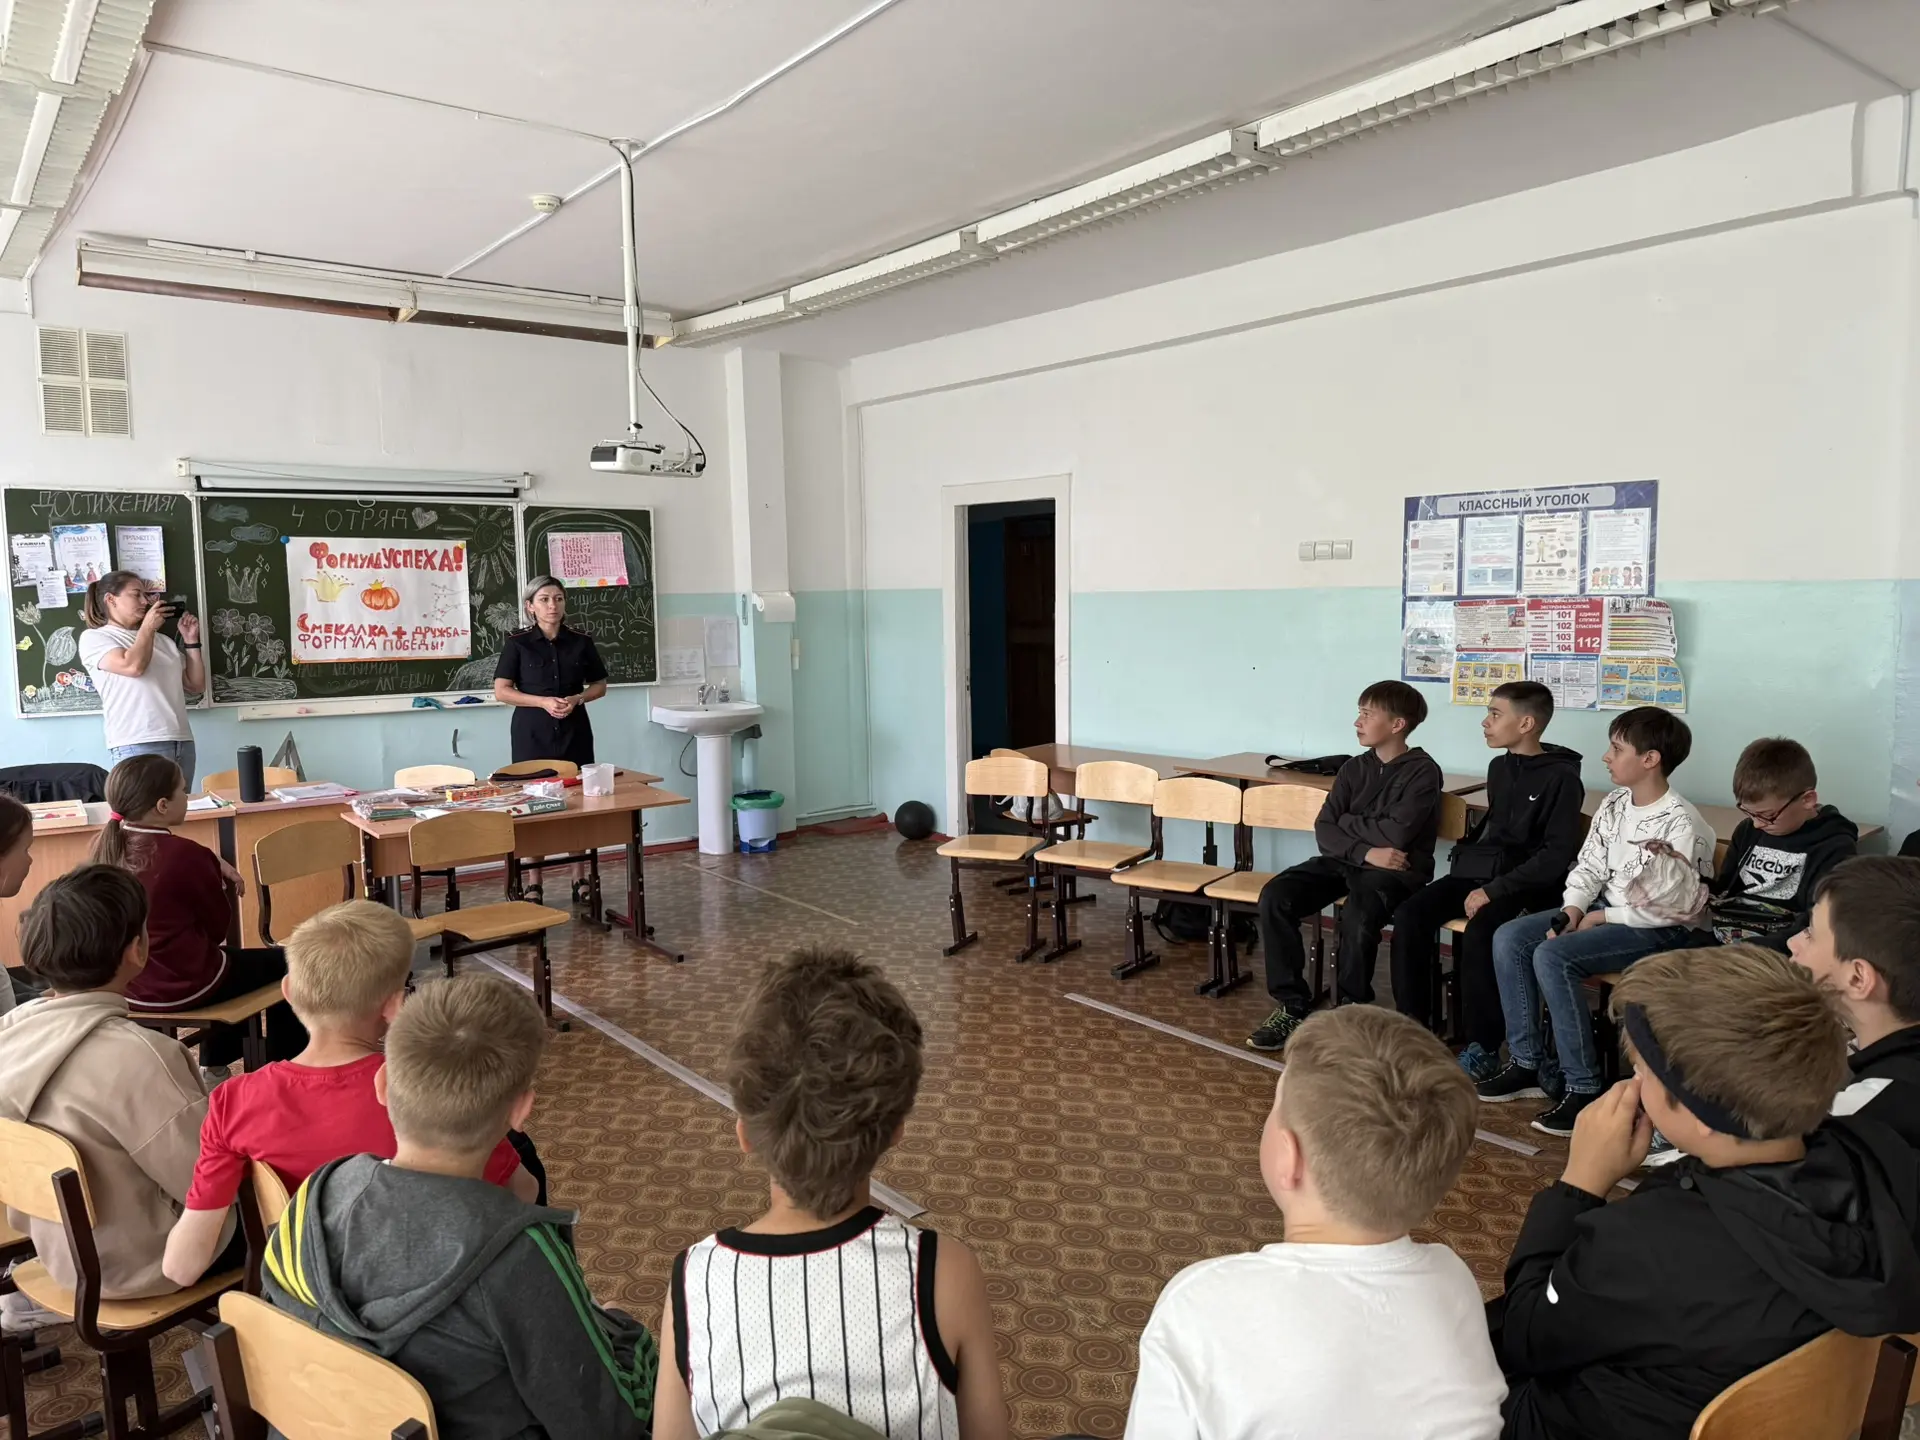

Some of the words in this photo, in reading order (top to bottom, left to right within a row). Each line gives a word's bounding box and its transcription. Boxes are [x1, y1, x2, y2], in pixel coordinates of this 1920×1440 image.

[31, 491, 177, 517] ДОСТИЖЕНИЯ!
[1458, 494, 1532, 512] КЛАССНЫЙ
[1535, 492, 1590, 507] УГОЛОК
[292, 504, 304, 528] 4
[325, 508, 407, 532] ОТРЯД
[381, 546, 464, 572] УСПЕХА!
[1556, 611, 1571, 619] 101
[1556, 622, 1572, 630] 102
[298, 633, 377, 650] ФОРМУЛА
[383, 636, 445, 651] ПОБЕДЫ!
[1556, 633, 1571, 641] 103
[1577, 637, 1600, 648] 112
[1556, 644, 1572, 652] 104
